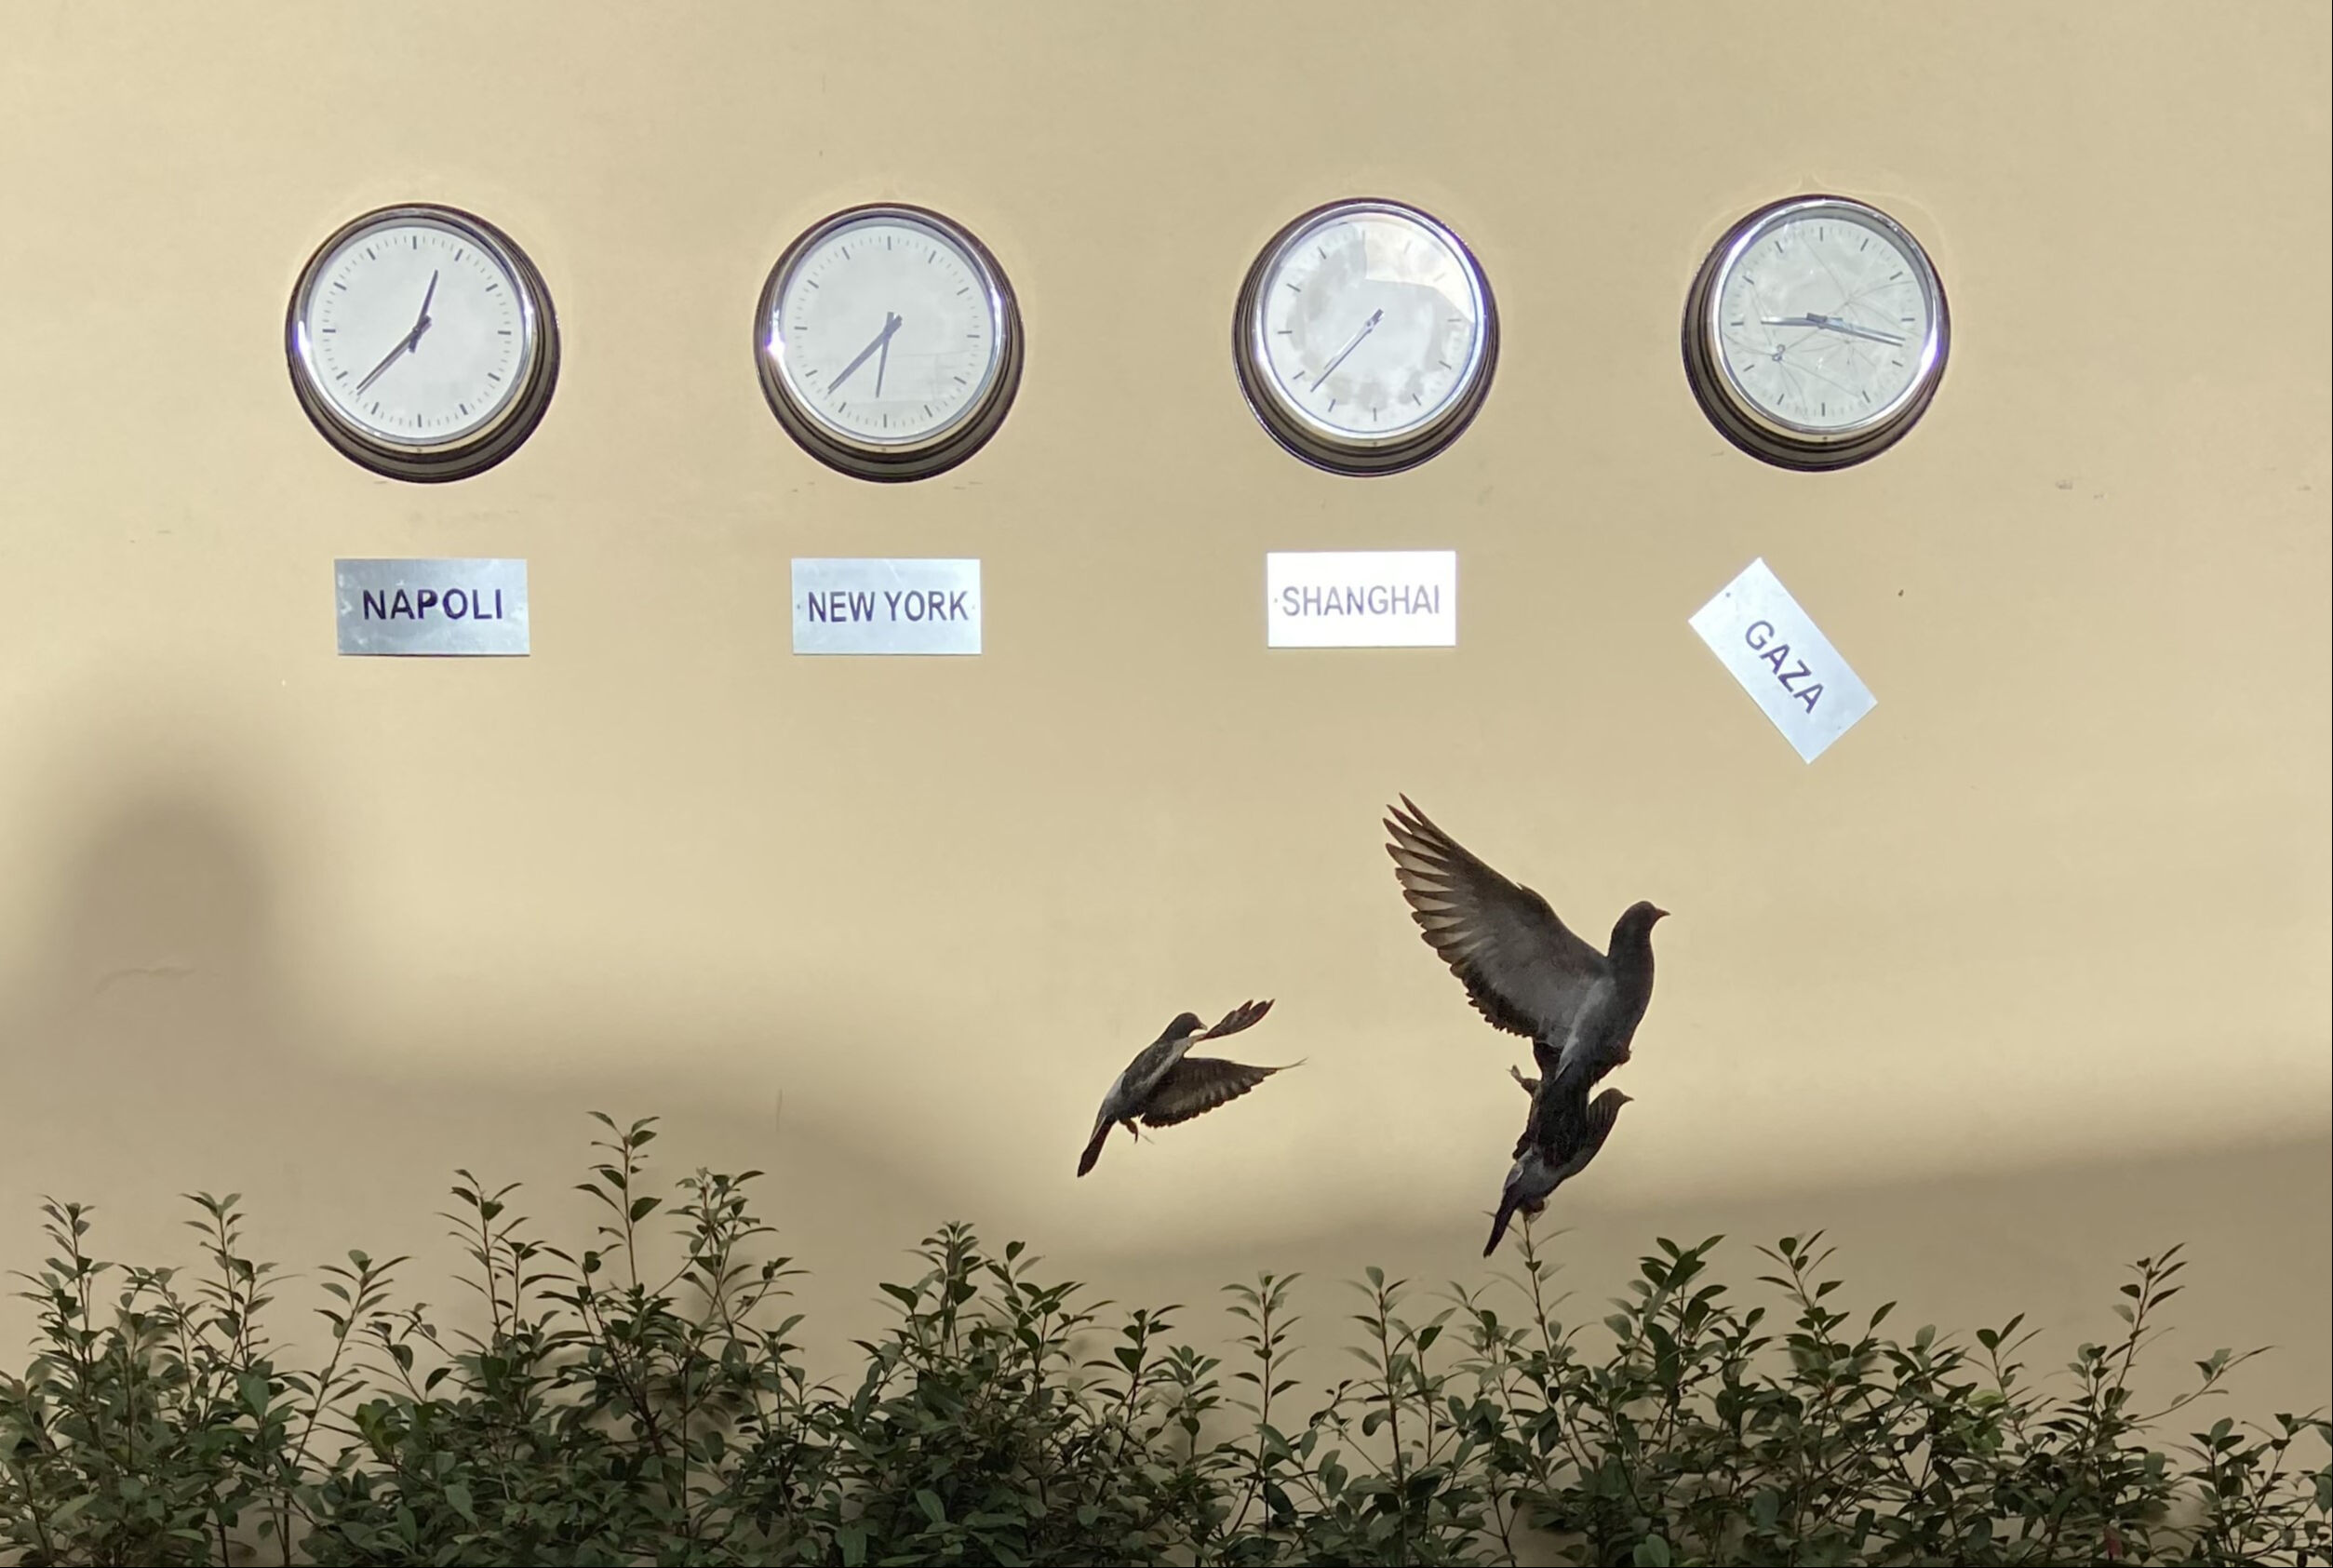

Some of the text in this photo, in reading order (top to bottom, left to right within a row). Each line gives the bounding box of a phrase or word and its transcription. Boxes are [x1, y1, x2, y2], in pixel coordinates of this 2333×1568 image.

[362, 588, 503, 621] NAPOLI
[808, 590, 969, 623] NEW YORK
[1281, 584, 1441, 618] SHANGHAI
[1745, 620, 1824, 714] GAZA
